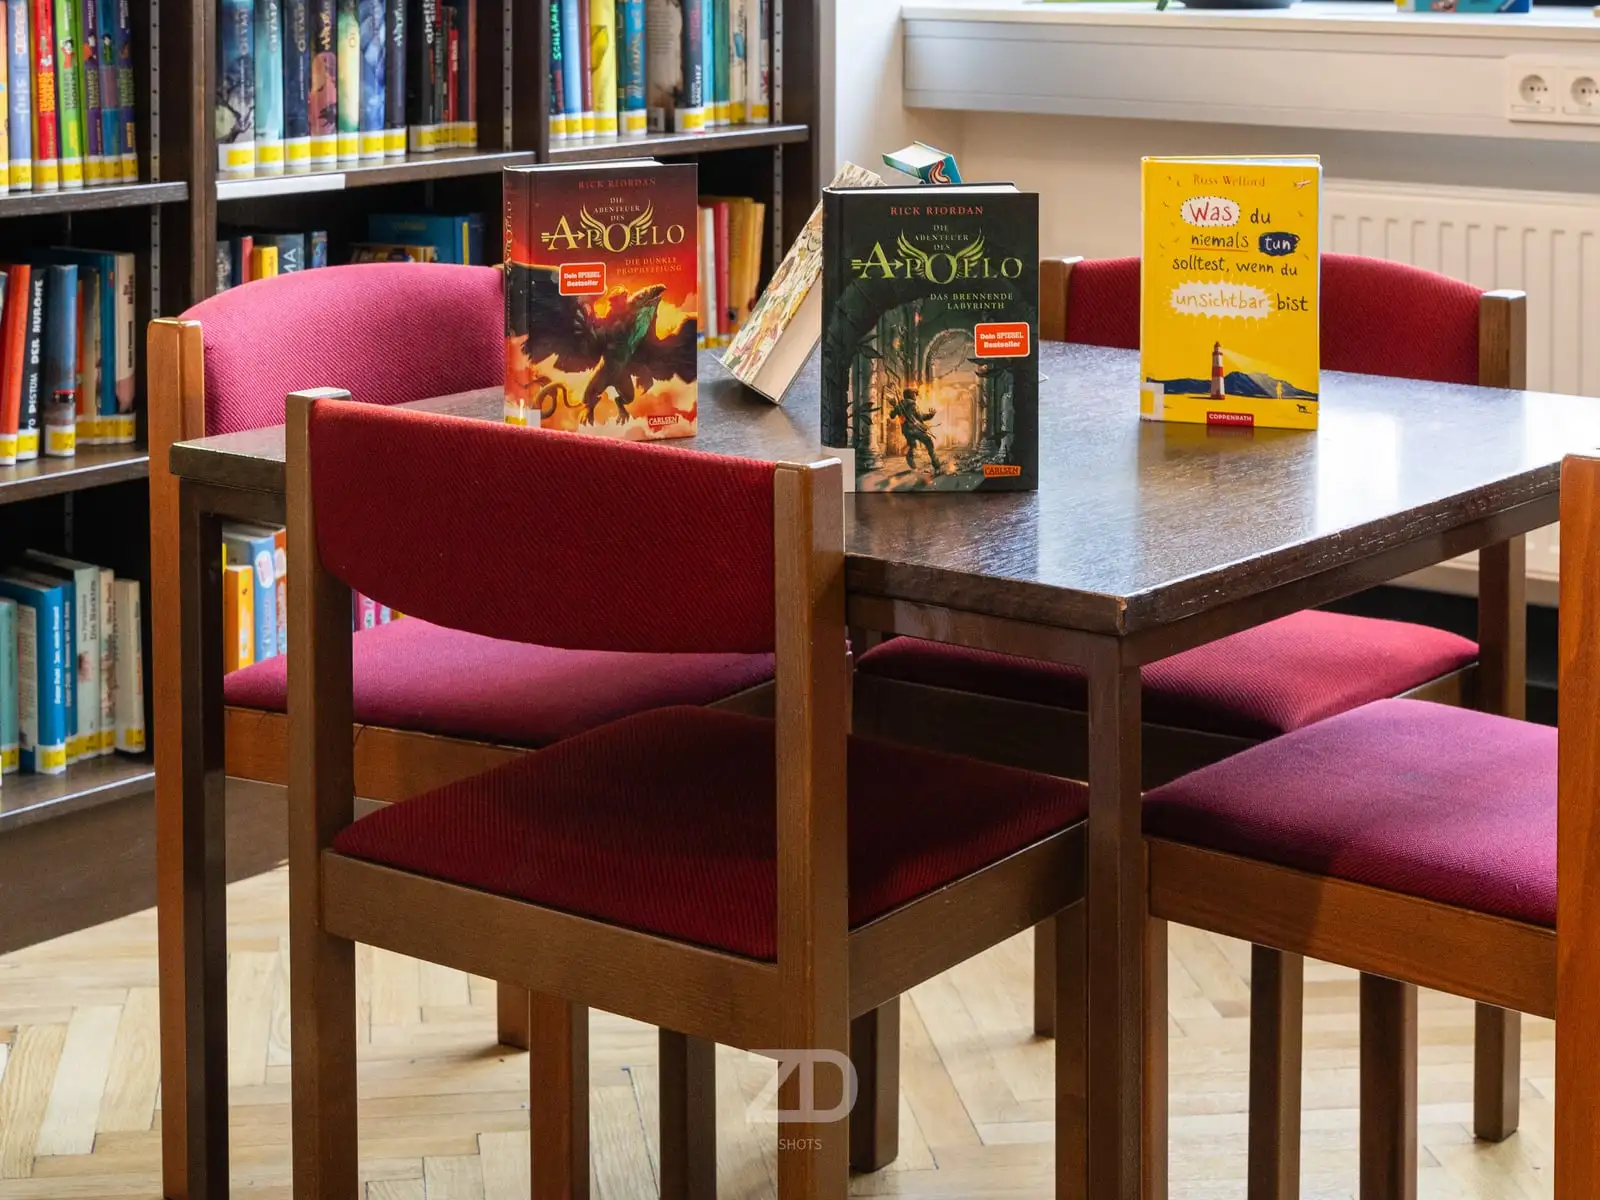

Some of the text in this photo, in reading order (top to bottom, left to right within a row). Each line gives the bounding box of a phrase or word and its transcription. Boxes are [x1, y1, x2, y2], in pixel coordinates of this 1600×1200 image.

[551, 3, 562, 60] SCHLAMM
[578, 177, 656, 189] RICK RIORDAN
[1193, 174, 1218, 185] Ross
[593, 205, 641, 213] ABENTEUER
[890, 206, 983, 215] RICK RIORDAN
[1189, 201, 1271, 224] Was du
[544, 215, 685, 252] APOLLO
[1191, 232, 1291, 251] niemals tun
[643, 257, 677, 265] DUNKLE
[854, 241, 1023, 285] APOLLO
[1172, 255, 1298, 276] solltest, wenn du
[930, 292, 1013, 301] DAS BRENNENDE
[1175, 289, 1309, 311] unsichtbar bist
[33, 279, 44, 333] HURONE
[947, 302, 1005, 310] LABYRINTH
[980, 332, 996, 340] Dein
[983, 340, 1021, 348] Bestseller
[31, 338, 40, 365] DER
[649, 416, 678, 426] CARLSEN
[1208, 413, 1252, 422] COPPENRATH
[986, 466, 1018, 475] CARLSEN
